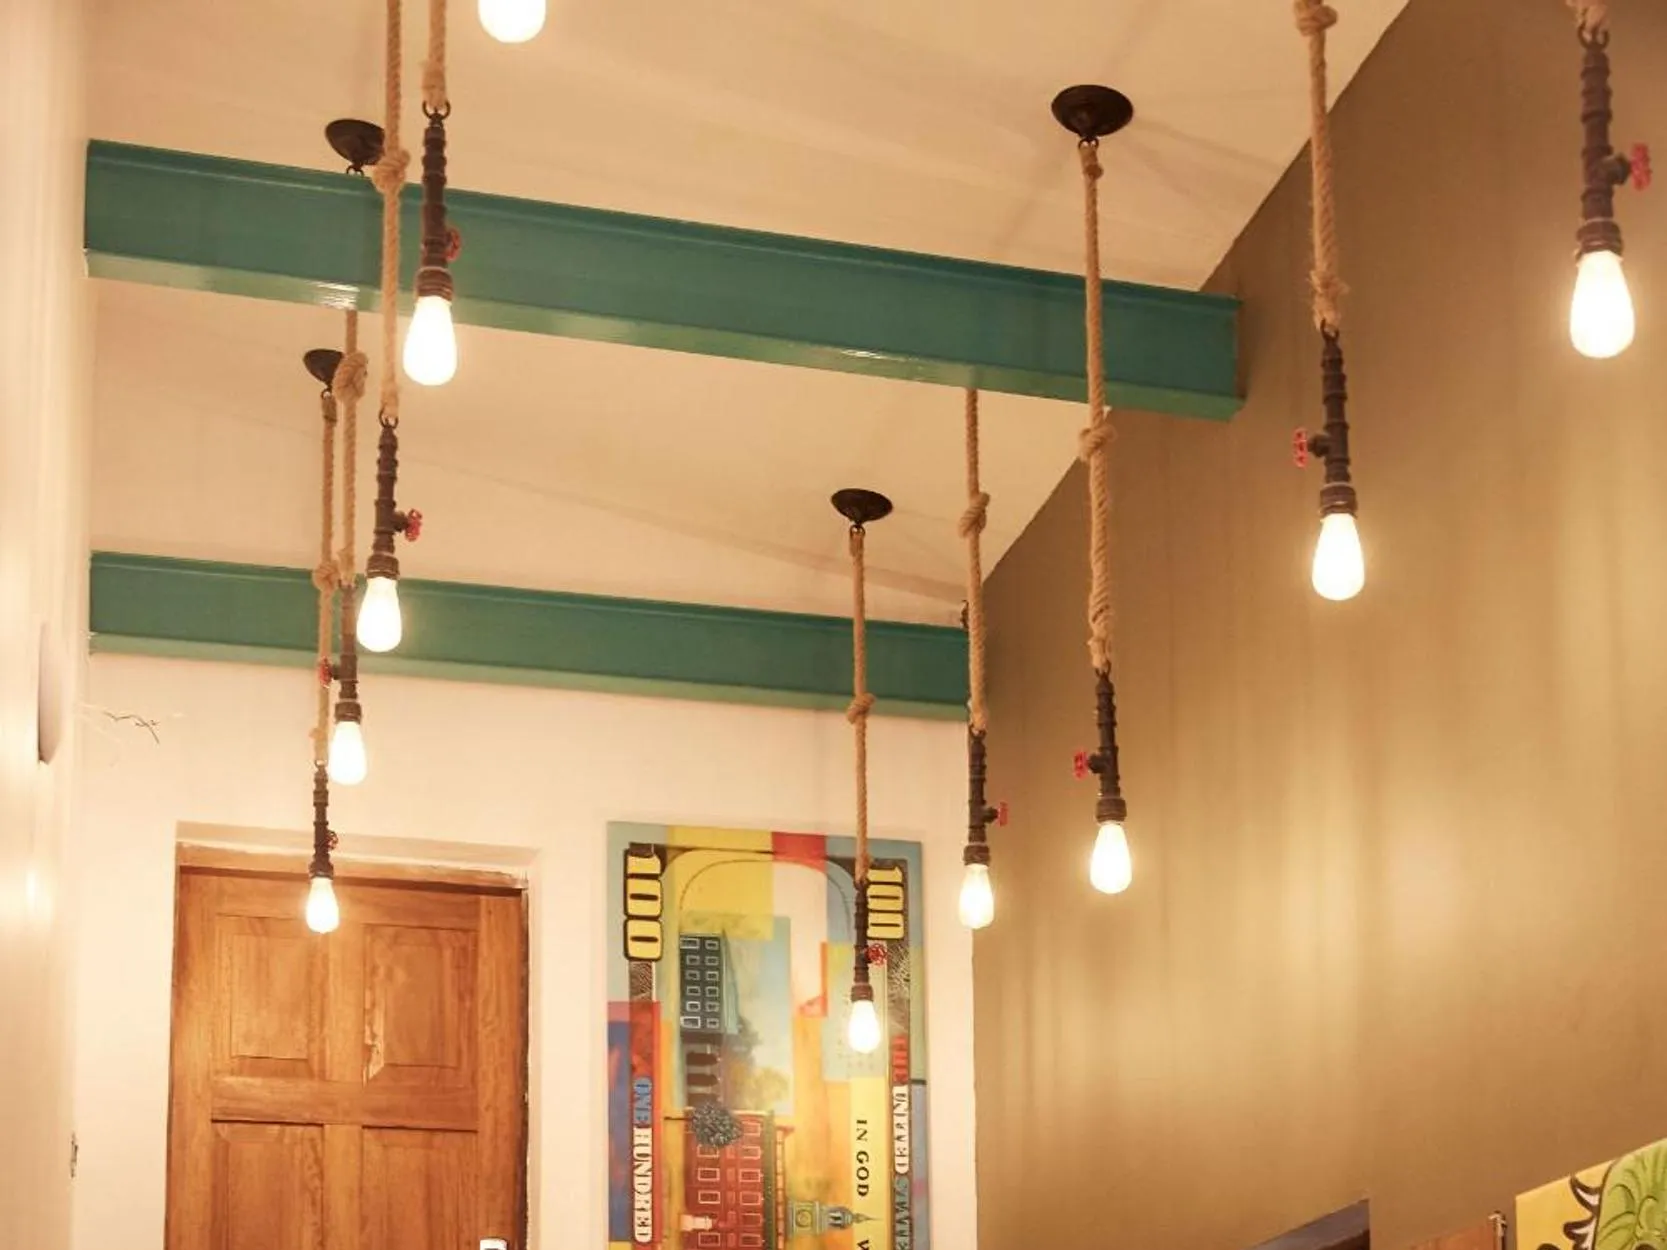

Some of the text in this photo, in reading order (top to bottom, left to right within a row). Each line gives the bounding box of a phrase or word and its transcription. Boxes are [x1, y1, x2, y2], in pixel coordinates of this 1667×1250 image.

[624, 849, 664, 960] 100
[866, 866, 905, 940] 100
[633, 1077, 652, 1126] ONE
[856, 1119, 868, 1142] IN
[892, 1085, 909, 1174] UNITED
[633, 1127, 653, 1243] HUNDRED
[856, 1150, 870, 1197] GOD
